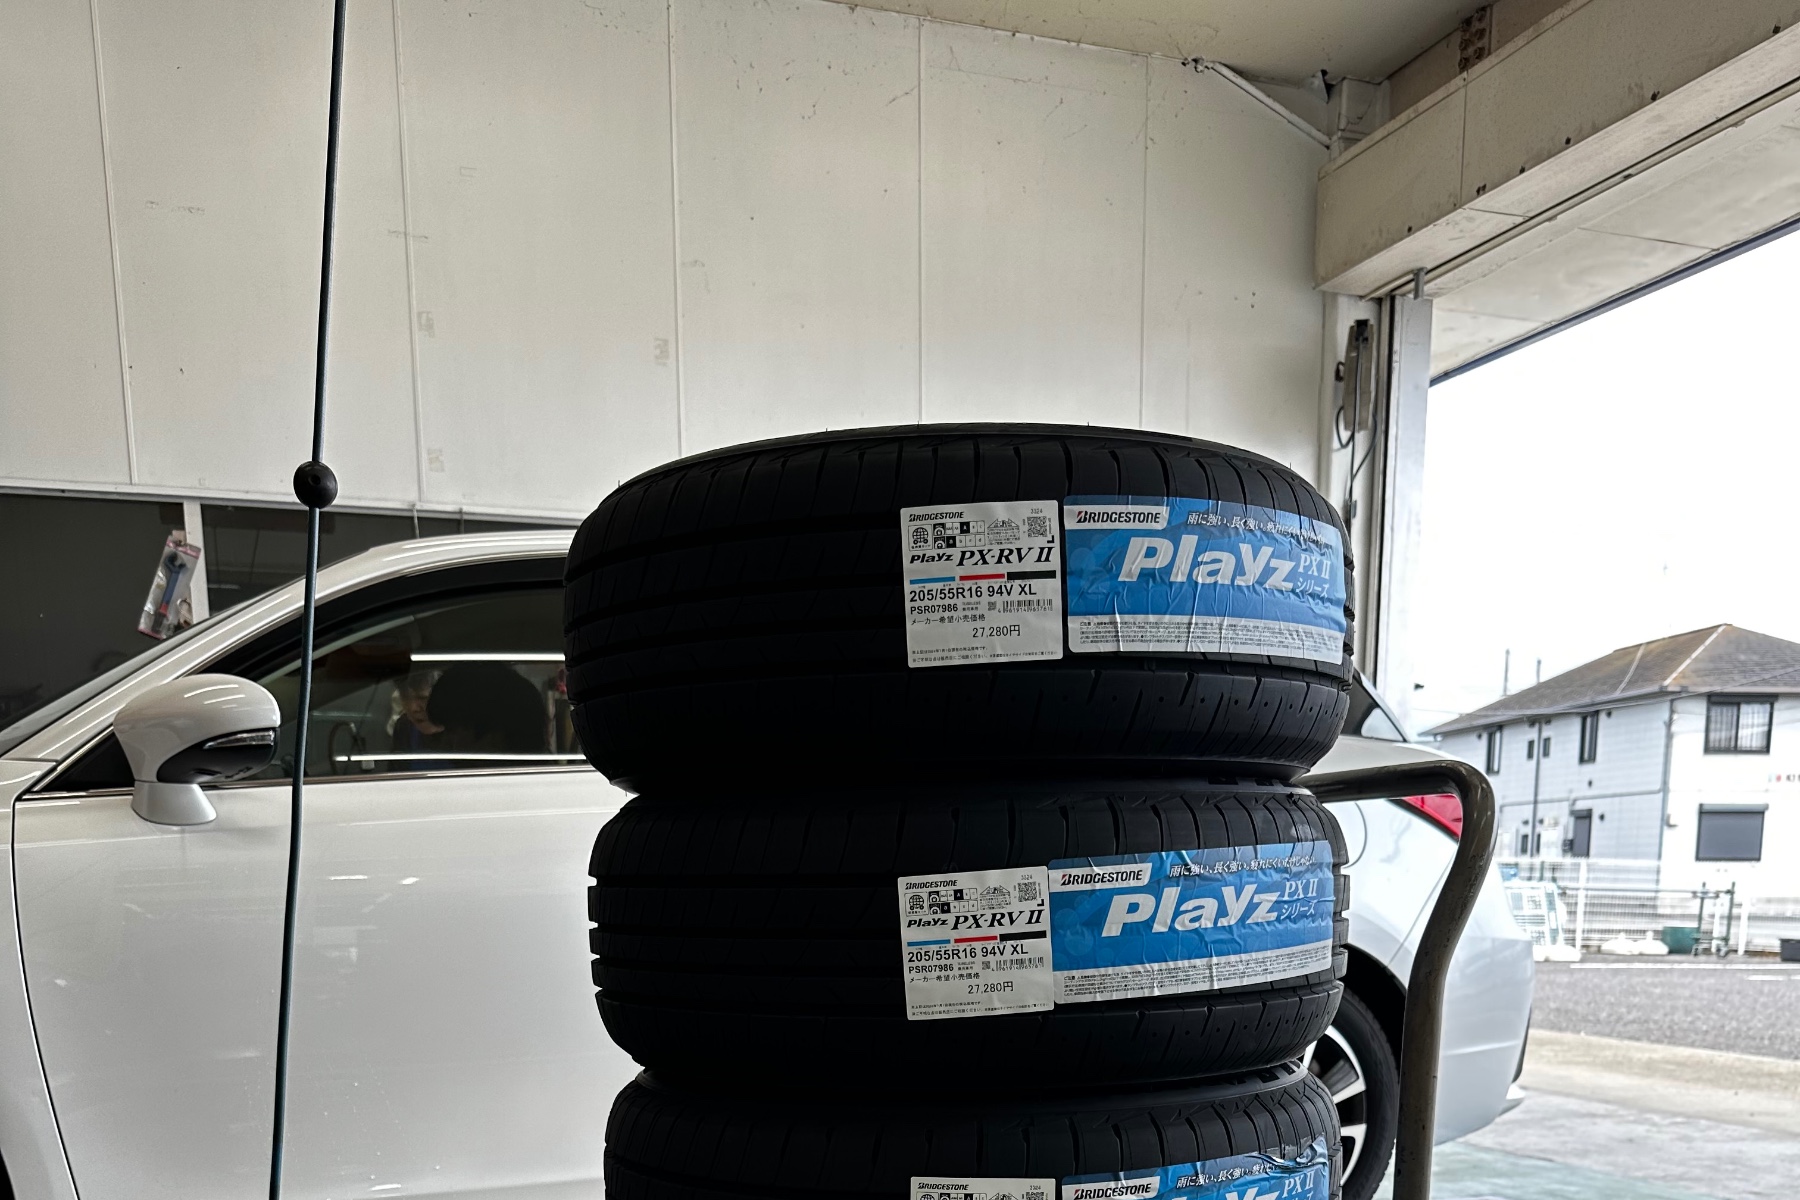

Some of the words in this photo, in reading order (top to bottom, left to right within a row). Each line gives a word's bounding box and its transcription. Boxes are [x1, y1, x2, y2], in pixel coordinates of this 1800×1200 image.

[908, 511, 964, 522] BRIDGESTONE
[1076, 510, 1160, 524] BRIDGESTONE
[909, 552, 954, 564] Playz
[956, 547, 1033, 566] PX-RV
[1117, 534, 1299, 591] Playz
[1298, 554, 1320, 577] PX
[909, 586, 983, 603] 205/55R16
[987, 584, 1014, 597] 94V
[1018, 584, 1037, 596] XL
[1295, 579, 1330, 599] シリーズ
[910, 603, 958, 615] PSR07986
[910, 614, 986, 625] メーカー希望小売価格
[972, 624, 1021, 638] 27,280円
[905, 879, 958, 890] BRIDGESTONE
[1060, 869, 1142, 887] BRIDGESTONE
[1283, 880, 1304, 899] PX
[1101, 884, 1281, 937] Playz
[1281, 900, 1316, 921] シリーズ
[907, 917, 948, 928] Playz
[950, 911, 1024, 930] PX-RV
[907, 947, 977, 963] 205/55R16
[981, 945, 1007, 958] 94V
[1011, 943, 1028, 956] XL
[908, 963, 954, 974] PSR07986
[967, 981, 1014, 994] 27,280円
[917, 1182, 969, 1190] BRIDGESTONE
[1074, 1183, 1151, 1200] BRIDGESTONE
[1281, 1175, 1303, 1199] PX
